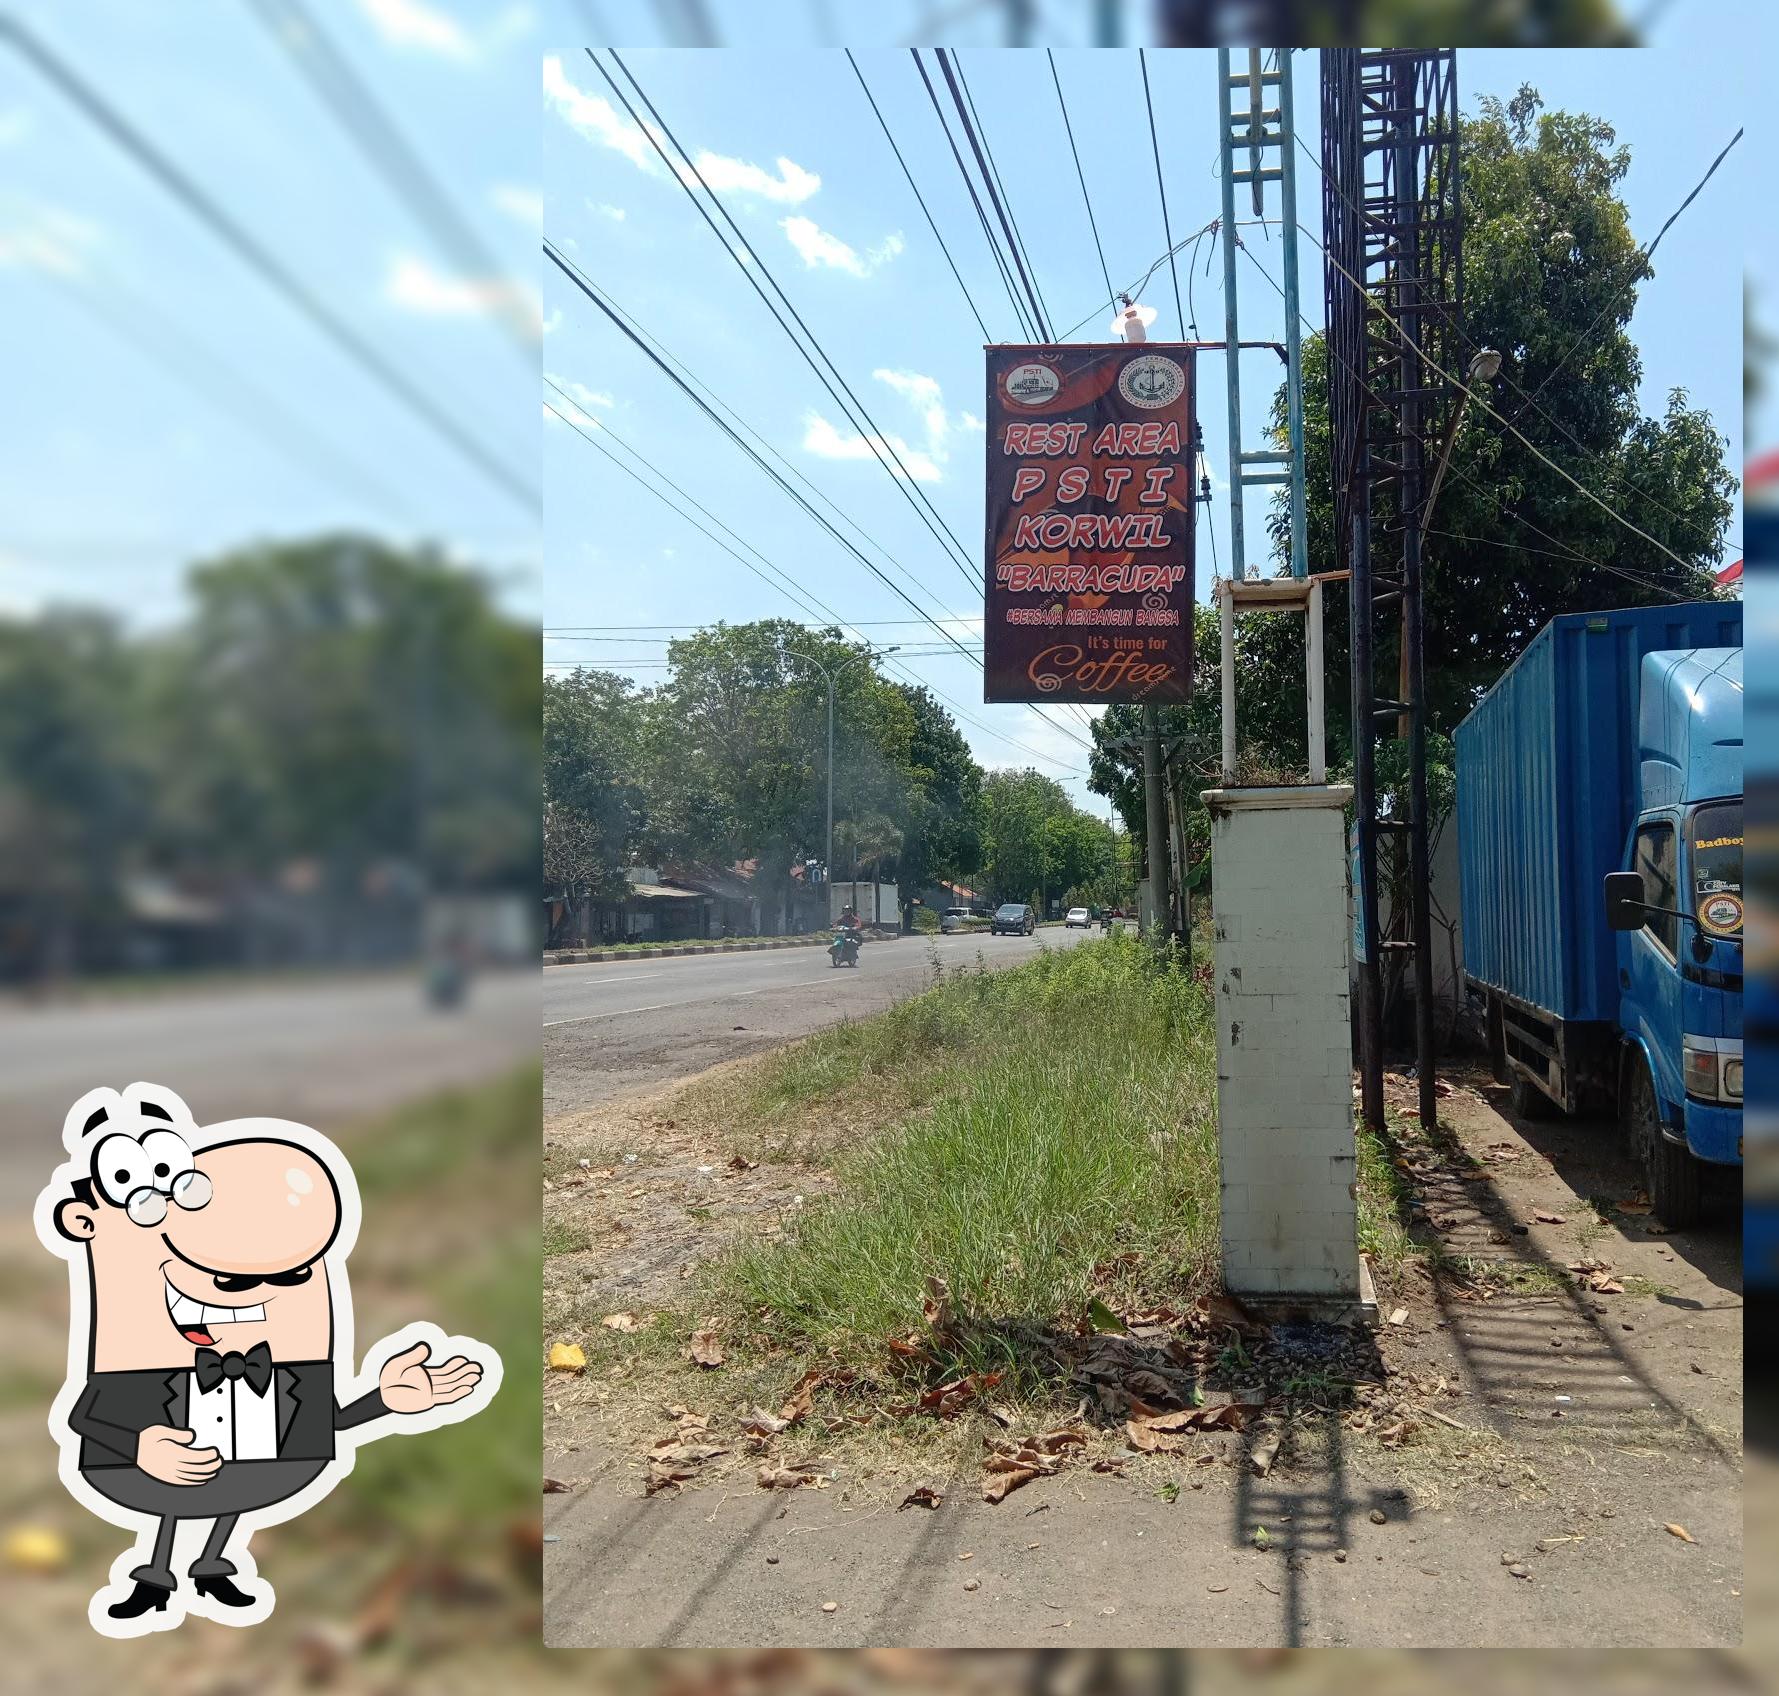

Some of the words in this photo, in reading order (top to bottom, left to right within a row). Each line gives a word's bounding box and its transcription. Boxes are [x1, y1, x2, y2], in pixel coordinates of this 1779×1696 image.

[1003, 422, 1088, 455] REST
[1093, 421, 1180, 455] AREA
[1014, 513, 1171, 549] KORWIL
[997, 564, 1186, 593] "BARRACUDA"
[1006, 608, 1063, 626] #BERSAMA
[1065, 608, 1133, 626] MEMBANGUN
[1136, 608, 1180, 626] BANGSA
[1088, 635, 1110, 650] It's
[1113, 636, 1145, 650] time
[1148, 636, 1168, 650] for
[1027, 644, 1168, 692] Coffee
